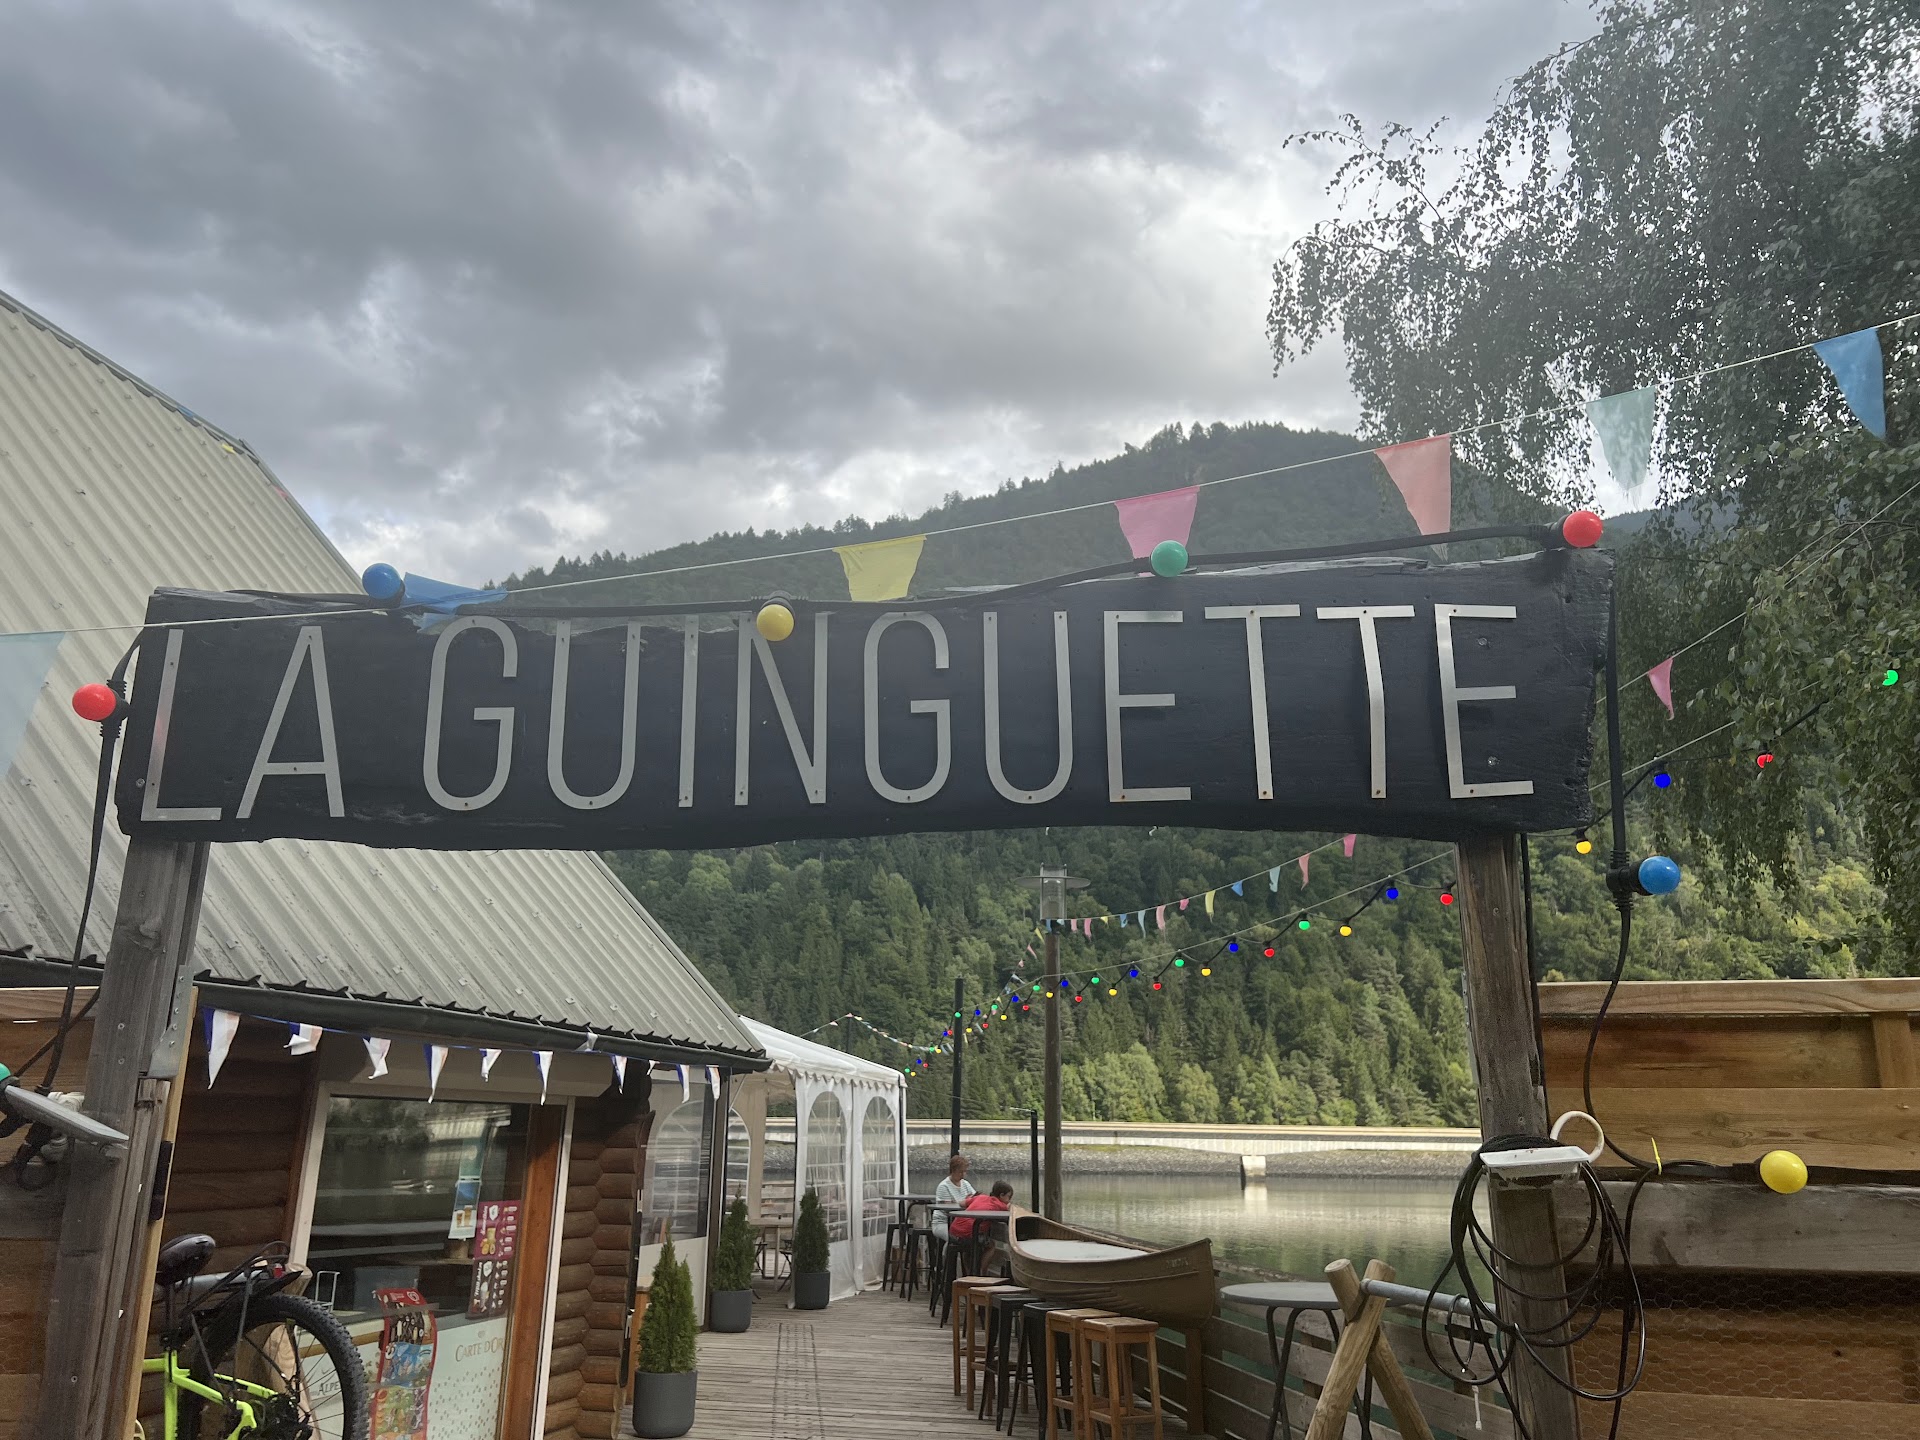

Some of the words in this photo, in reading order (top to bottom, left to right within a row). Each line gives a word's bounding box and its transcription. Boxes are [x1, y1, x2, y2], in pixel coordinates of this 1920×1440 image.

[140, 625, 345, 821] LA
[422, 603, 1534, 811] GUINGUETTE
[455, 1345, 482, 1363] CARTE
[317, 1381, 341, 1396] ALPE
